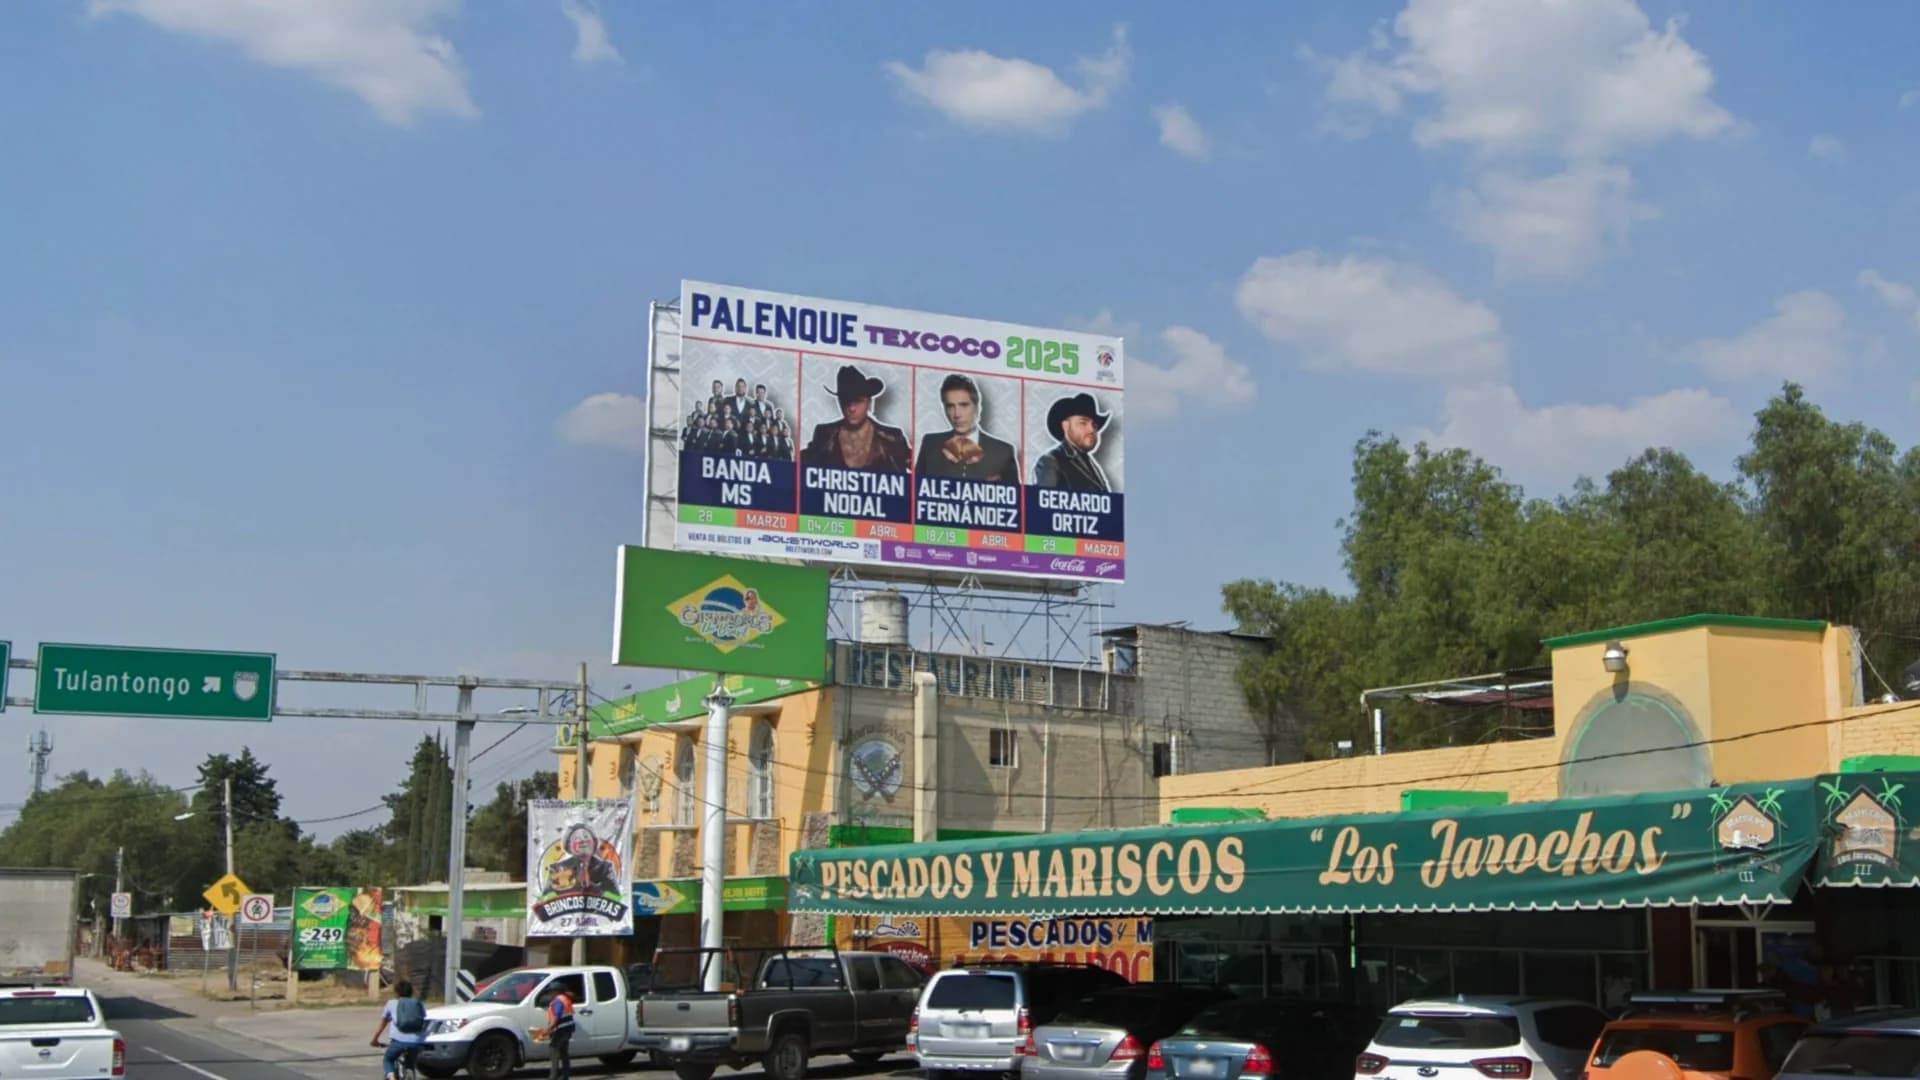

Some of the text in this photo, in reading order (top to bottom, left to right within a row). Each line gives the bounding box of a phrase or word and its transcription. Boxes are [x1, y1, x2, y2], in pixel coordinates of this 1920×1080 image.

[691, 292, 858, 347] PALENQUE
[864, 324, 1001, 359] TEXCOCO
[1006, 336, 1079, 375] 2025
[702, 456, 772, 484] BANDA
[806, 467, 905, 496] CHRISTIAN
[721, 482, 752, 506] MS
[919, 477, 1017, 505] ALEJANDRO
[1039, 489, 1111, 513] GERARDO
[824, 492, 887, 518] NODAL
[917, 500, 1018, 528] FERNÁNDEZ
[746, 514, 787, 529] MARZO
[869, 525, 898, 539] ABRIL
[1052, 513, 1098, 535] ORTIZ
[981, 534, 1009, 547] ABRIL
[1084, 543, 1120, 557] MARZO
[54, 667, 190, 701] Tulantongo
[820, 836, 1245, 899] PESCADOS Y MARISCOS
[543, 896, 585, 916] BRINCOS
[586, 897, 622, 917] DIERAS
[560, 918, 572, 927] 27
[970, 920, 1112, 949] PESCADOS
